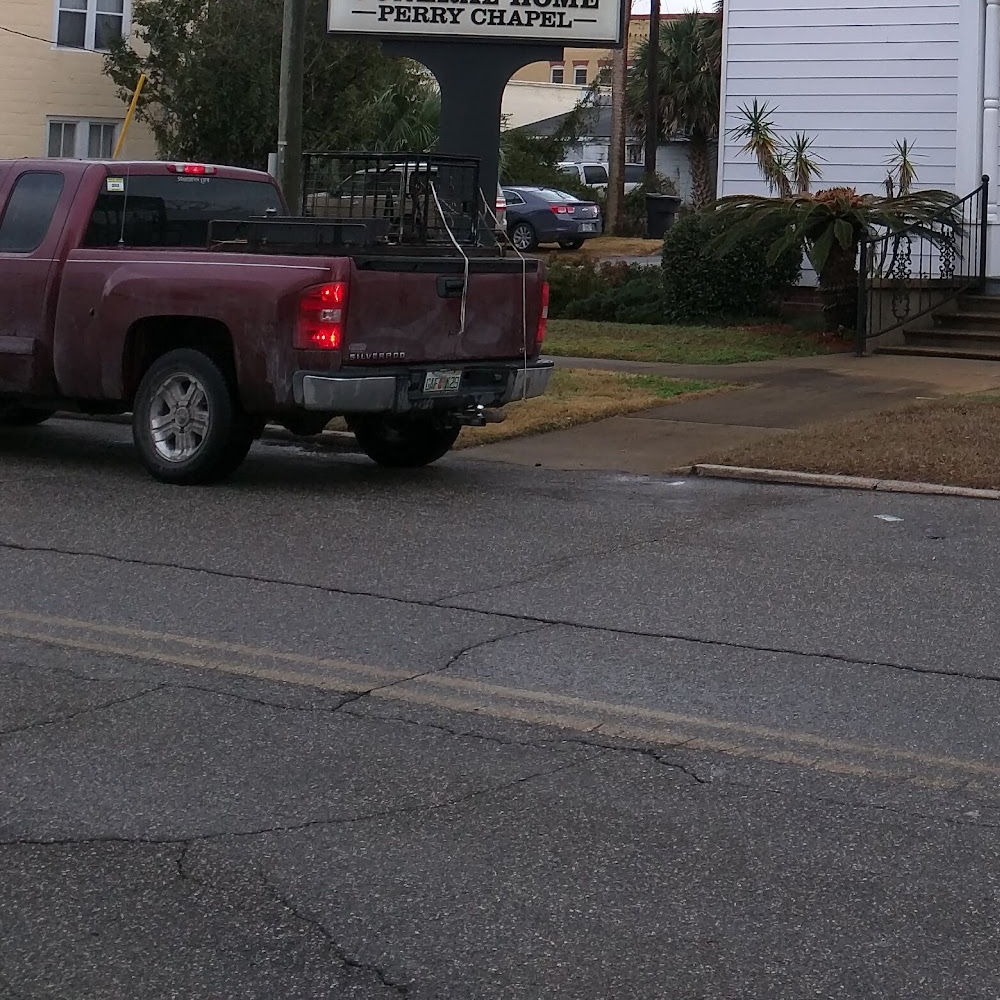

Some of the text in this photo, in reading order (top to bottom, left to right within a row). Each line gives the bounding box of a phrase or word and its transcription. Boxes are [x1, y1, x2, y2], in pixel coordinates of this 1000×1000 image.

[377, 5, 573, 28] PERRY CHAPEL
[349, 352, 406, 361] SILVERADO
